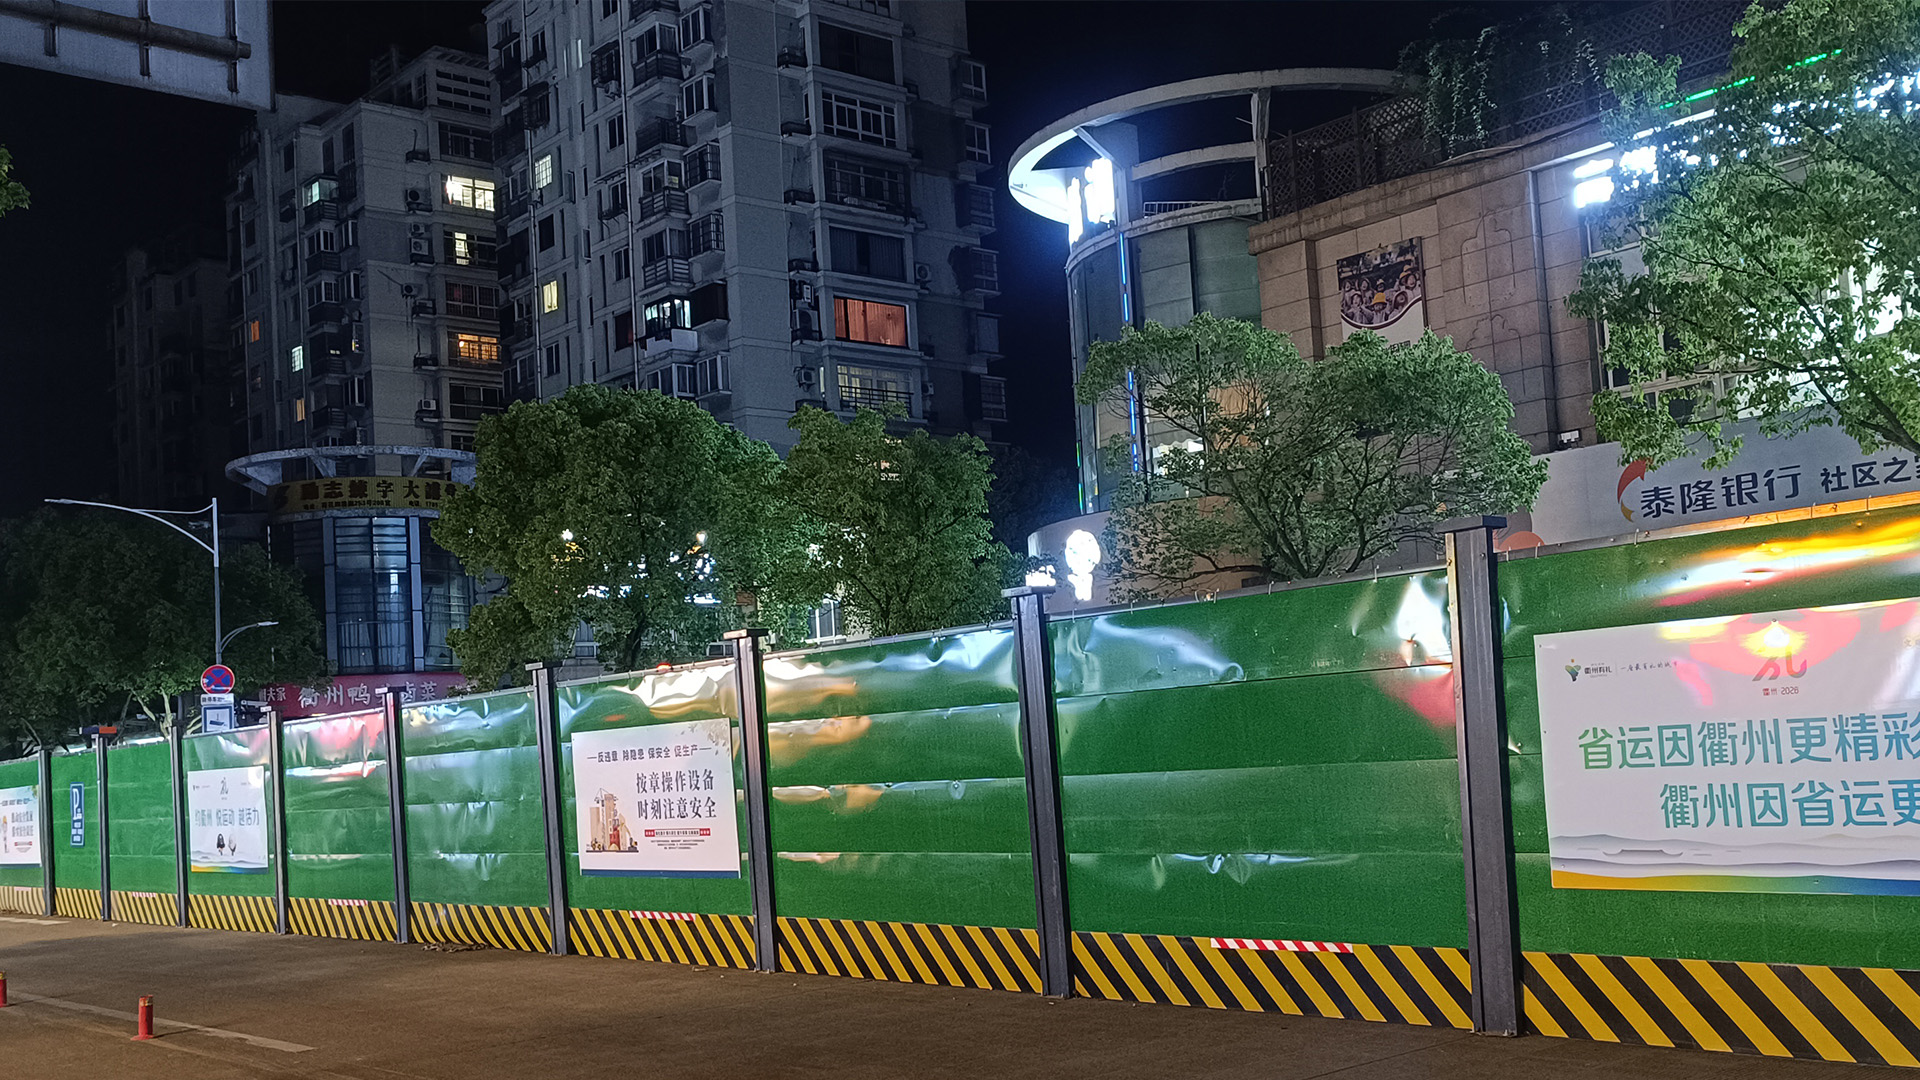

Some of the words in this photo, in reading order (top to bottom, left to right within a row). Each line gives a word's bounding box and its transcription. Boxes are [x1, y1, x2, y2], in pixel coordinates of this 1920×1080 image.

[1640, 464, 1802, 518] 泰隆银行
[1820, 456, 1920, 494] 社区之
[597, 750, 618, 763] 反违章
[622, 748, 645, 762] 除隐患
[648, 746, 671, 759] 保安全
[674, 744, 698, 758] 促生产
[1578, 711, 1920, 770] 省运因衢州更精彩
[636, 768, 714, 794] 按章操作设备
[637, 796, 717, 821] 时刻注意安全
[1659, 779, 1920, 829] 衢州因省运更
